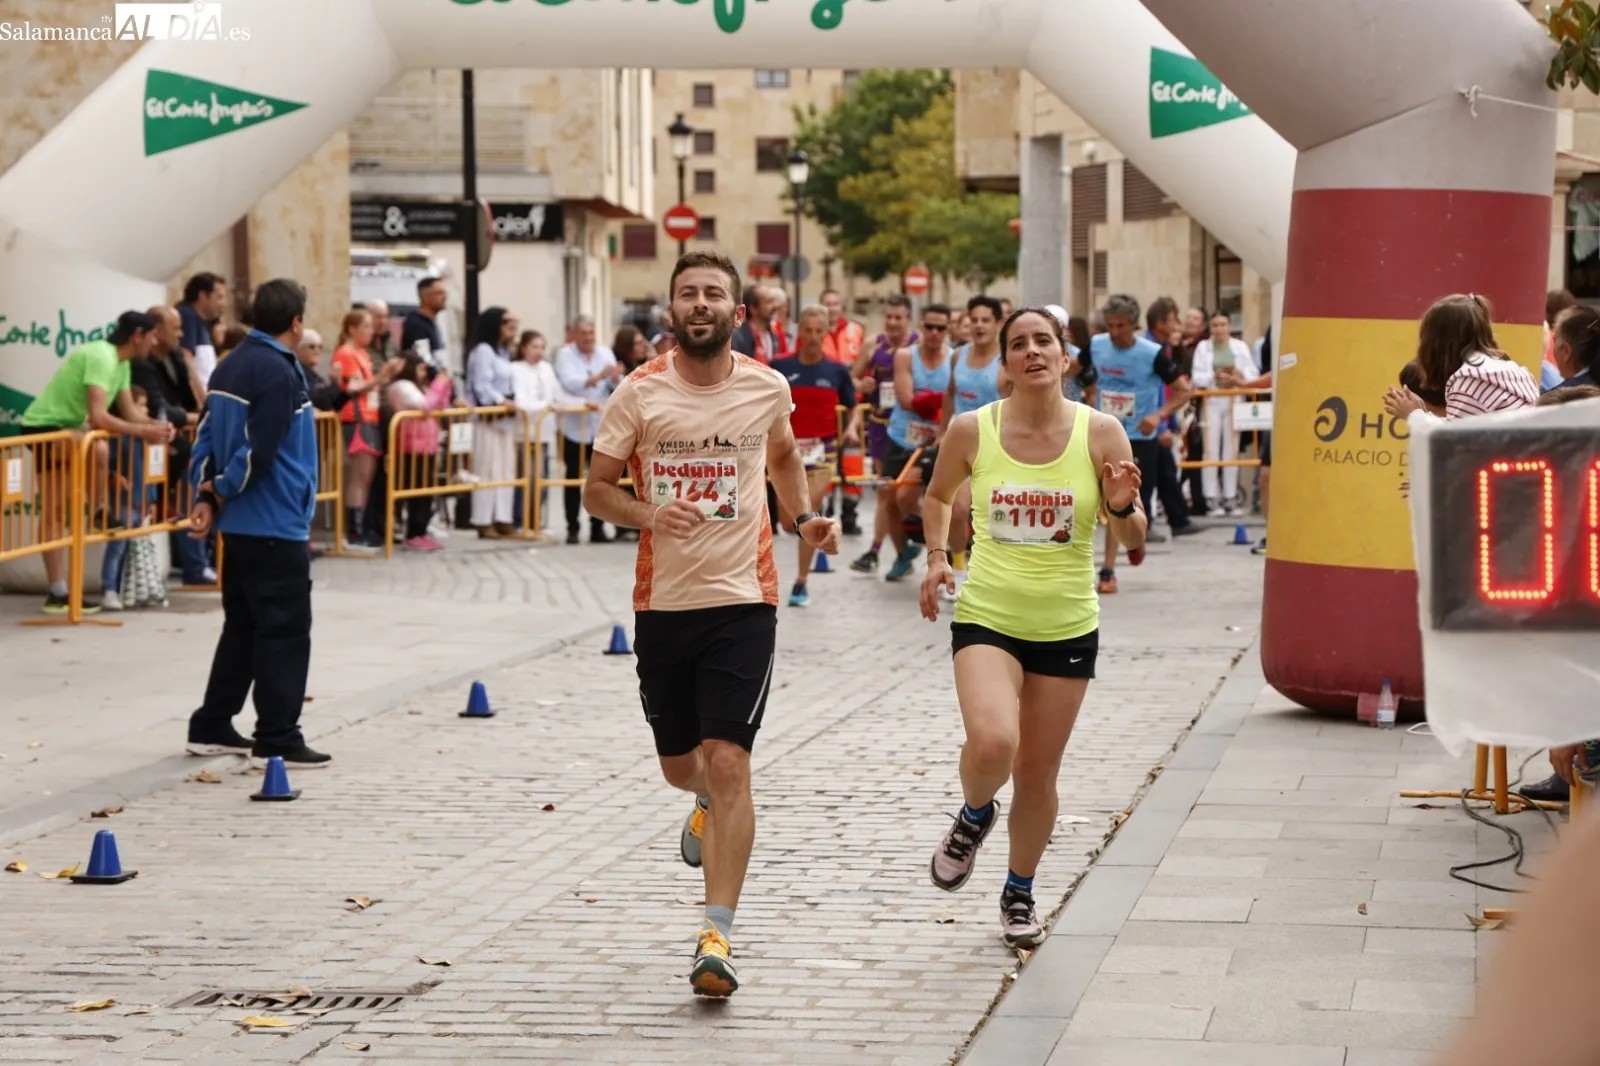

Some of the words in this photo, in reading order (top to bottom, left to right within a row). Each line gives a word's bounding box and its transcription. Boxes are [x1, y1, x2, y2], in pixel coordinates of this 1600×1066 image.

[1152, 80, 1171, 102] El
[1171, 81, 1217, 103] Corte
[165, 97, 208, 118] Corte
[666, 440, 696, 449] MEDIA
[740, 435, 762, 447] 2022
[1313, 447, 1392, 466] PALACIO
[653, 461, 736, 478] bedunia
[991, 489, 1073, 507] bedunia
[1009, 507, 1055, 528] 110
[1479, 459, 1600, 600] 0
